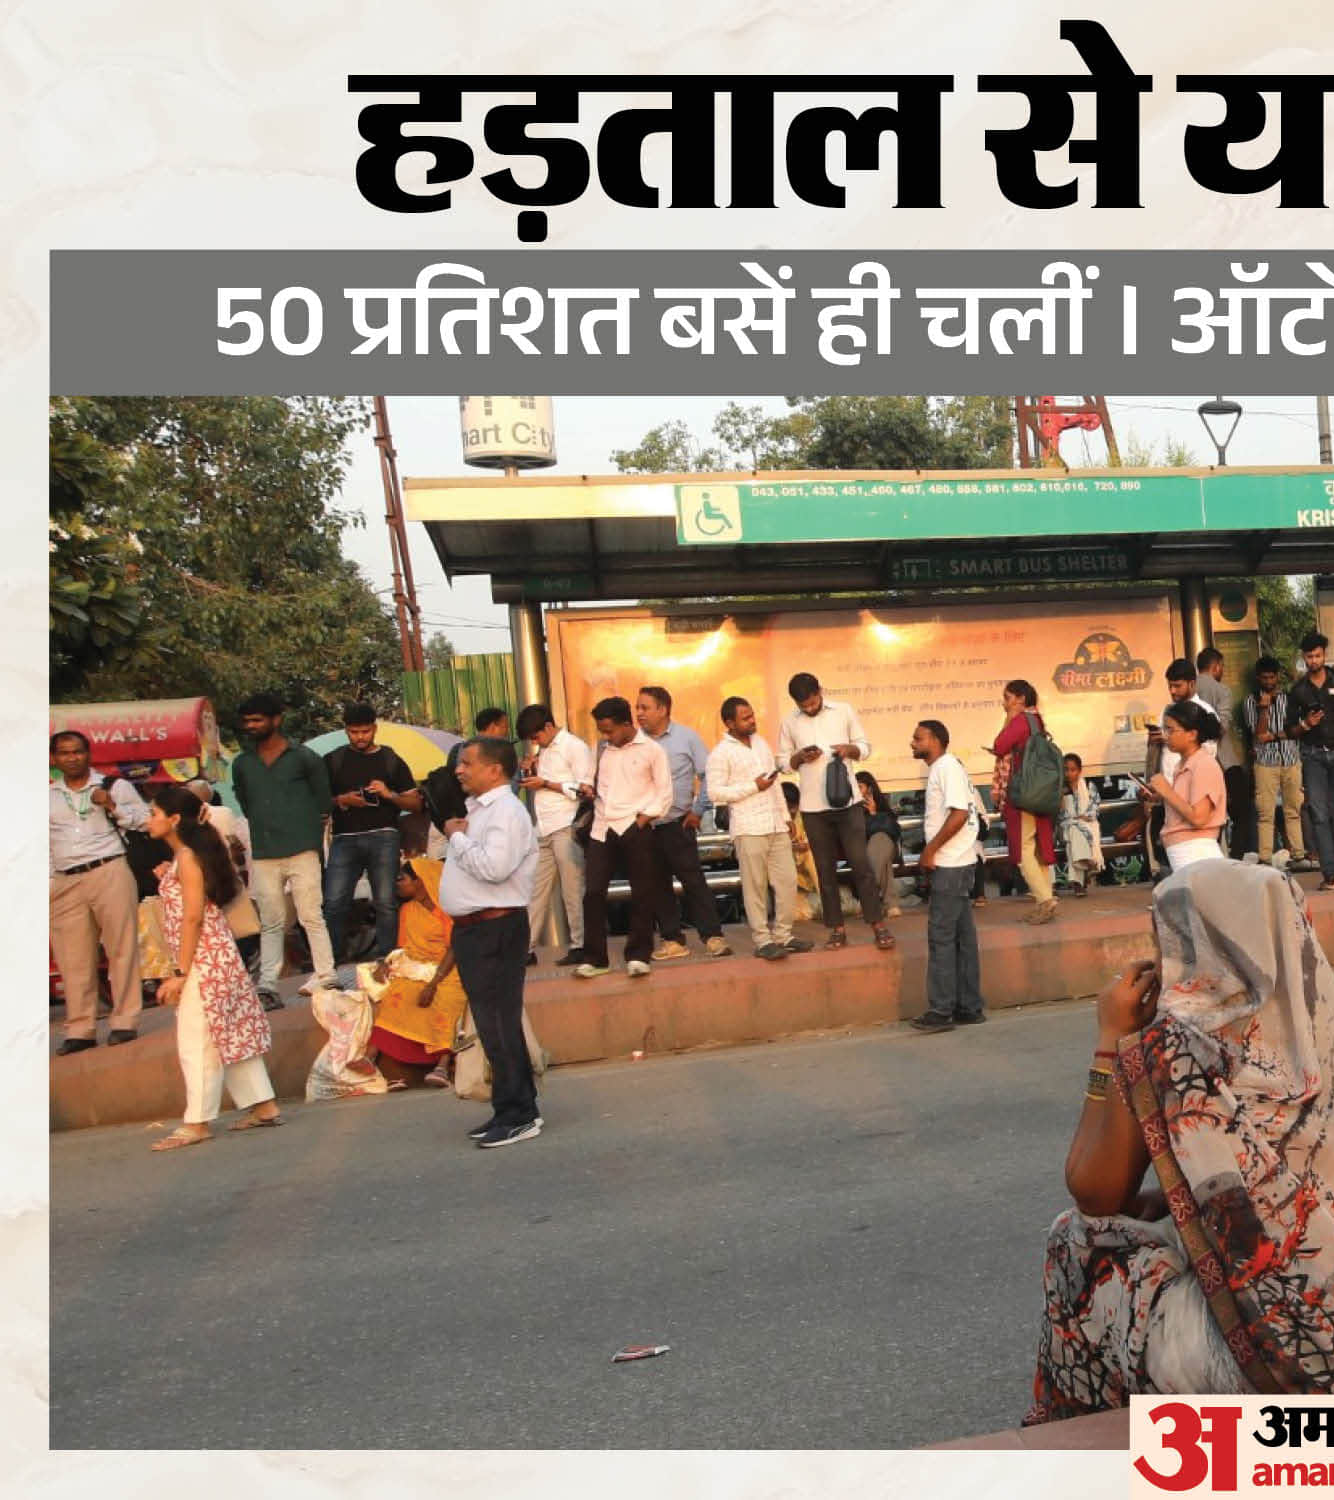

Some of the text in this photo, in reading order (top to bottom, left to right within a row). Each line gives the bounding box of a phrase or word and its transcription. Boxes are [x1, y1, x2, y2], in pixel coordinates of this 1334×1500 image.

[951, 554, 1129, 577] SMART BUS SHELTER
[90, 727, 168, 744] WALL'S
